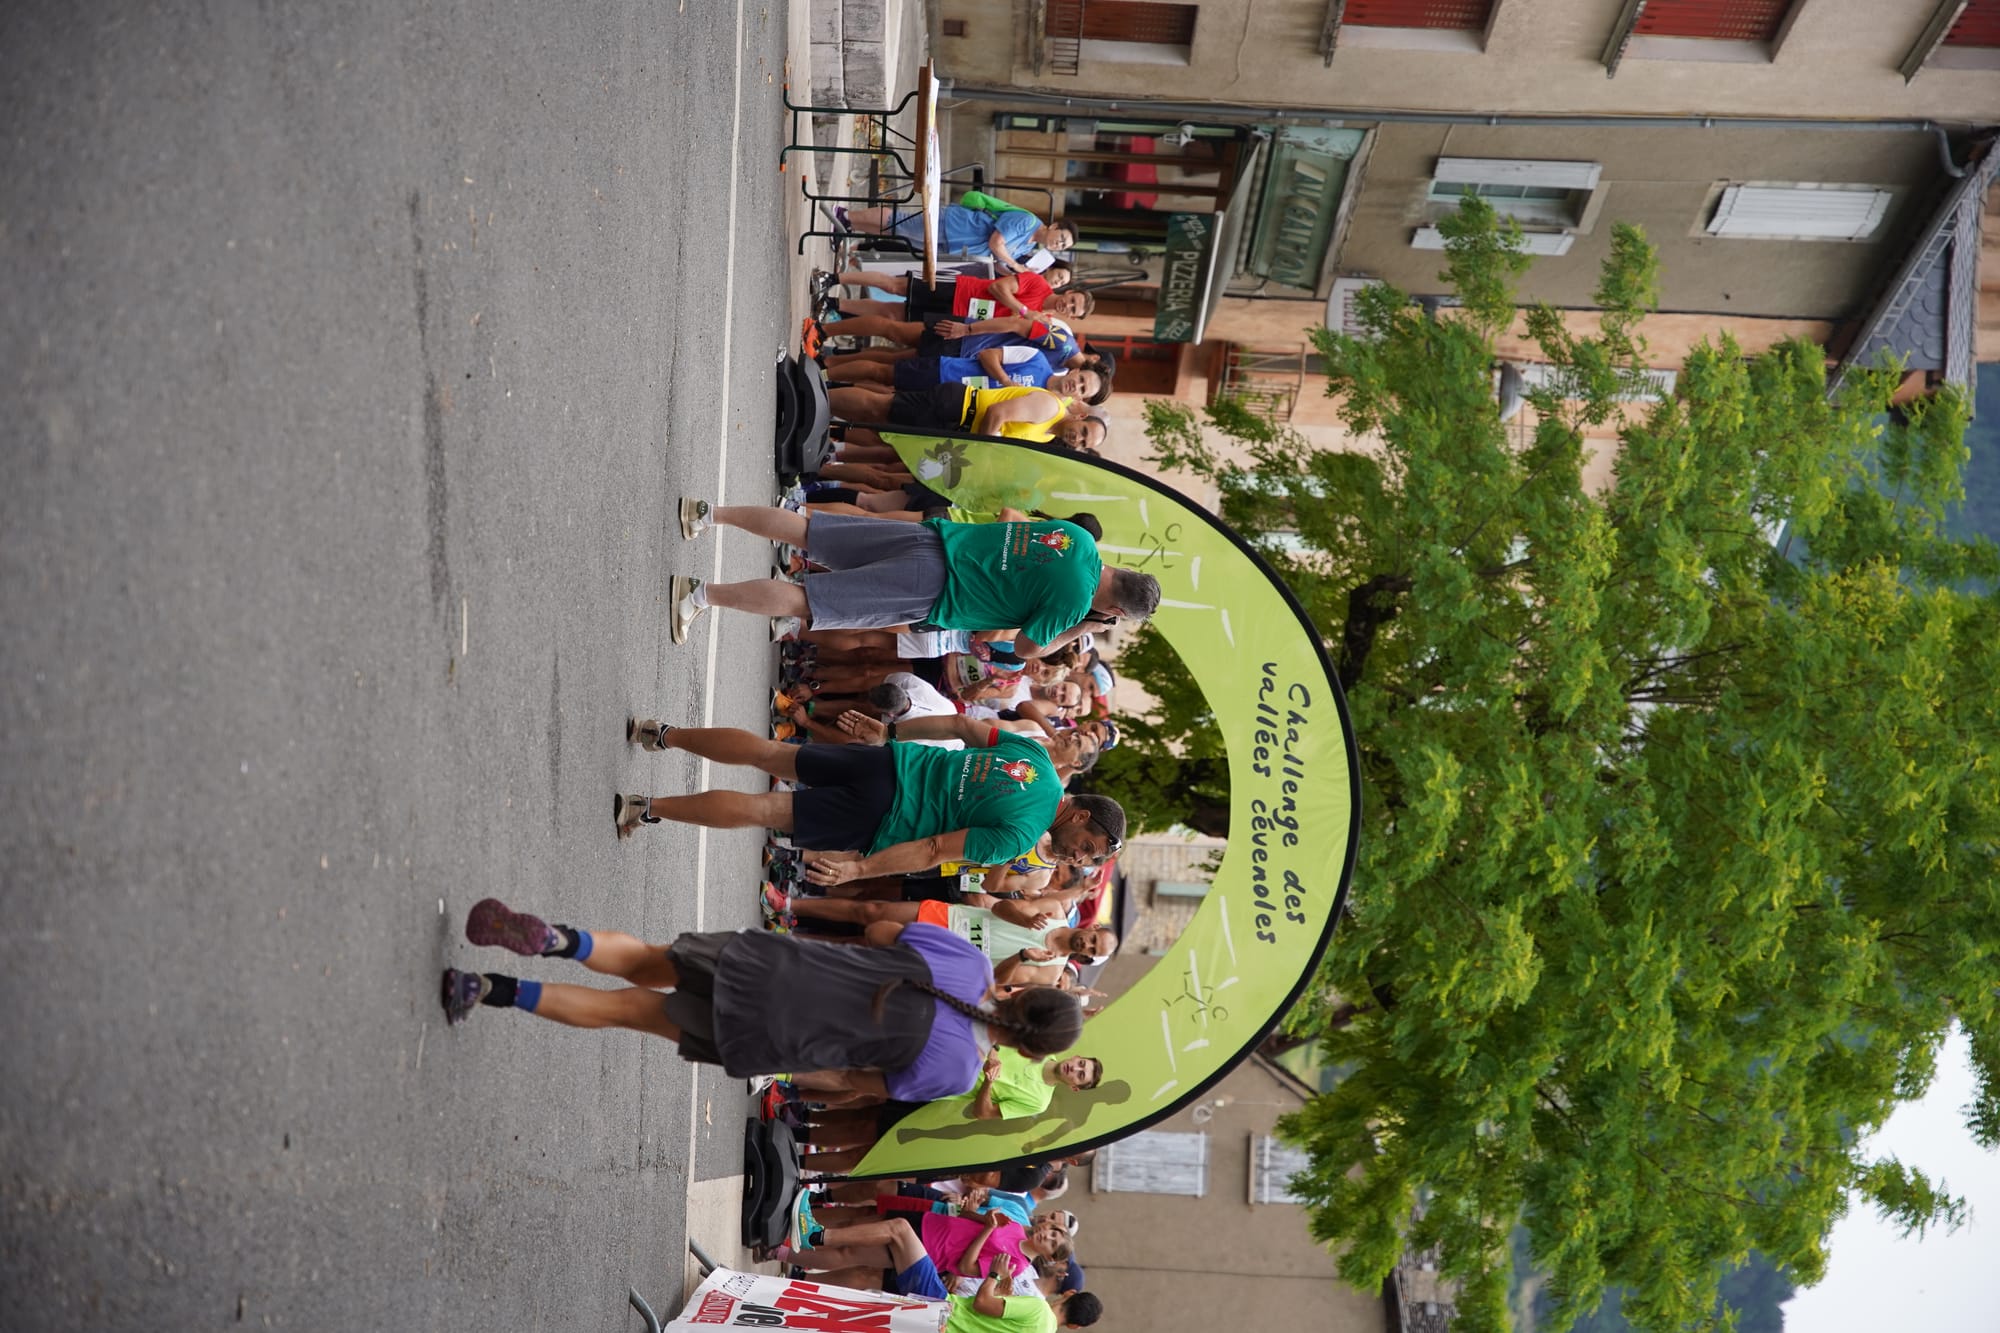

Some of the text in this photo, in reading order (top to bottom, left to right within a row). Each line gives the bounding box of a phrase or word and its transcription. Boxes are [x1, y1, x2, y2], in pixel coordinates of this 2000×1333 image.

[1166, 250, 1200, 310] PIZZERIA
[967, 665, 980, 682] 49
[1251, 662, 1278, 944] vallées cévenoles
[1272, 683, 1311, 924] Challenge des
